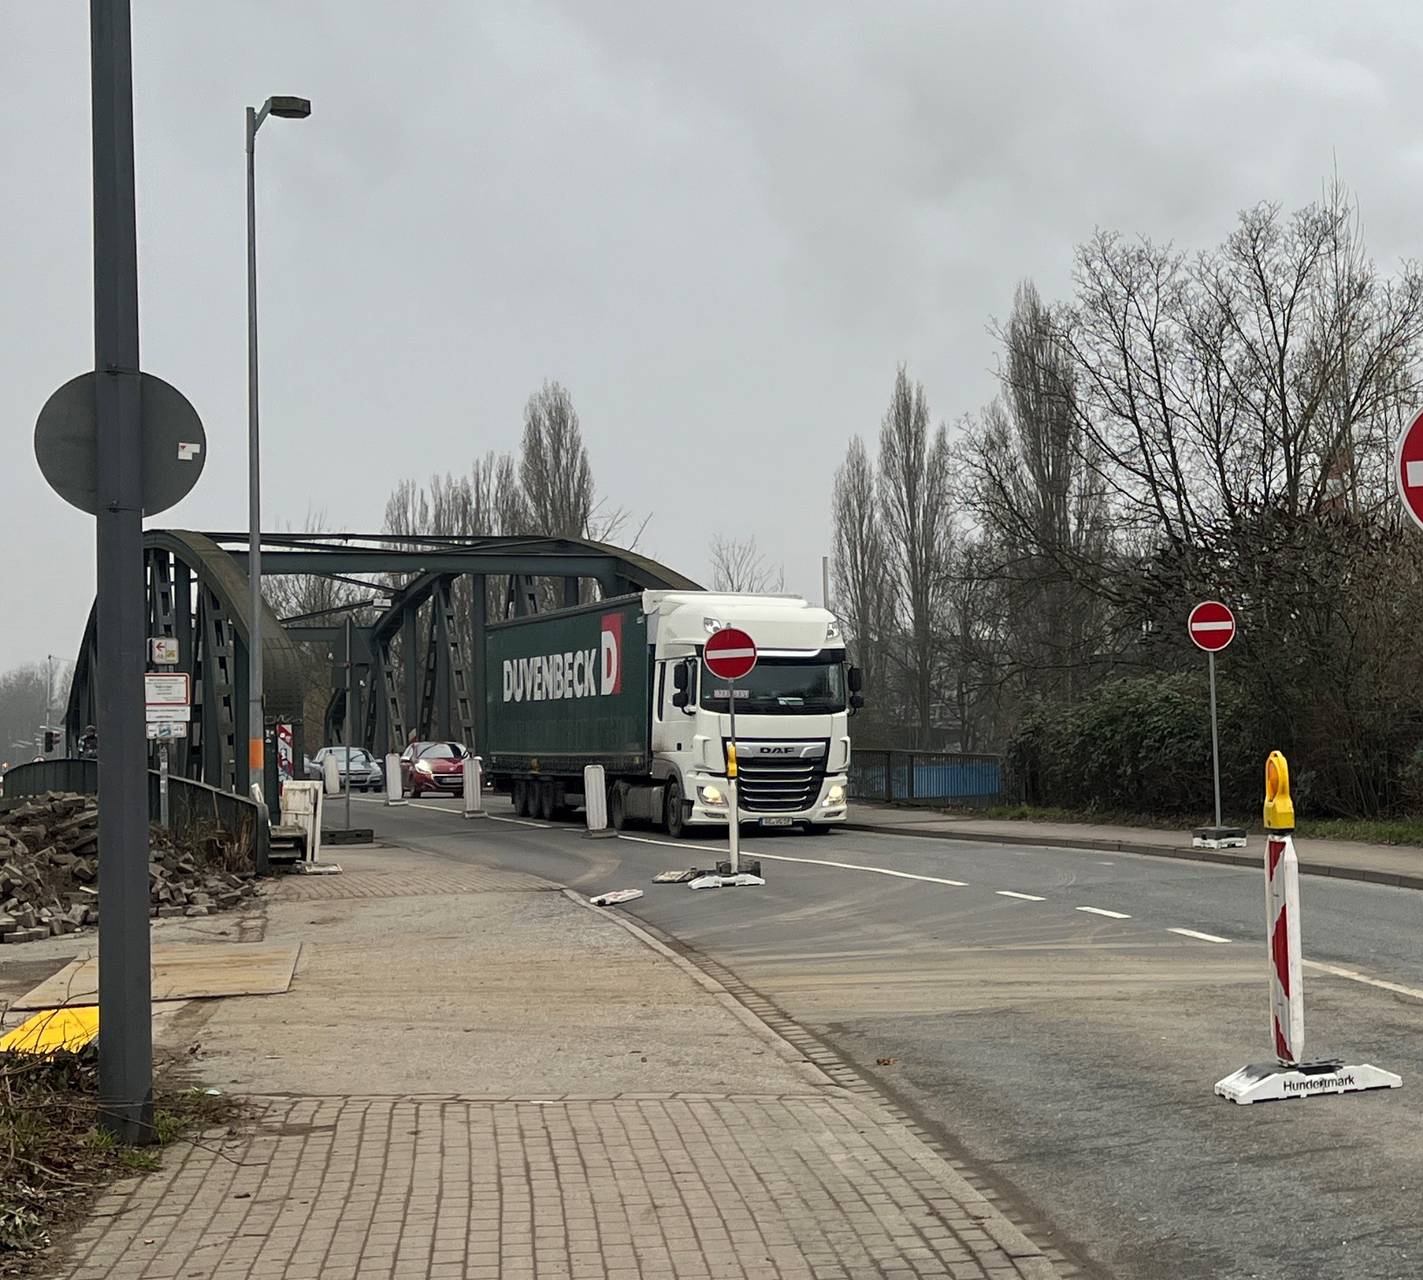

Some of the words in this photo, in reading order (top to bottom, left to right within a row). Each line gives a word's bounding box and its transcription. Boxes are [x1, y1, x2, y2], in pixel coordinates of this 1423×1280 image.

[503, 648, 597, 703] DUVENBECK
[600, 630, 618, 696] D
[1283, 1074, 1356, 1092] Hundertmark
